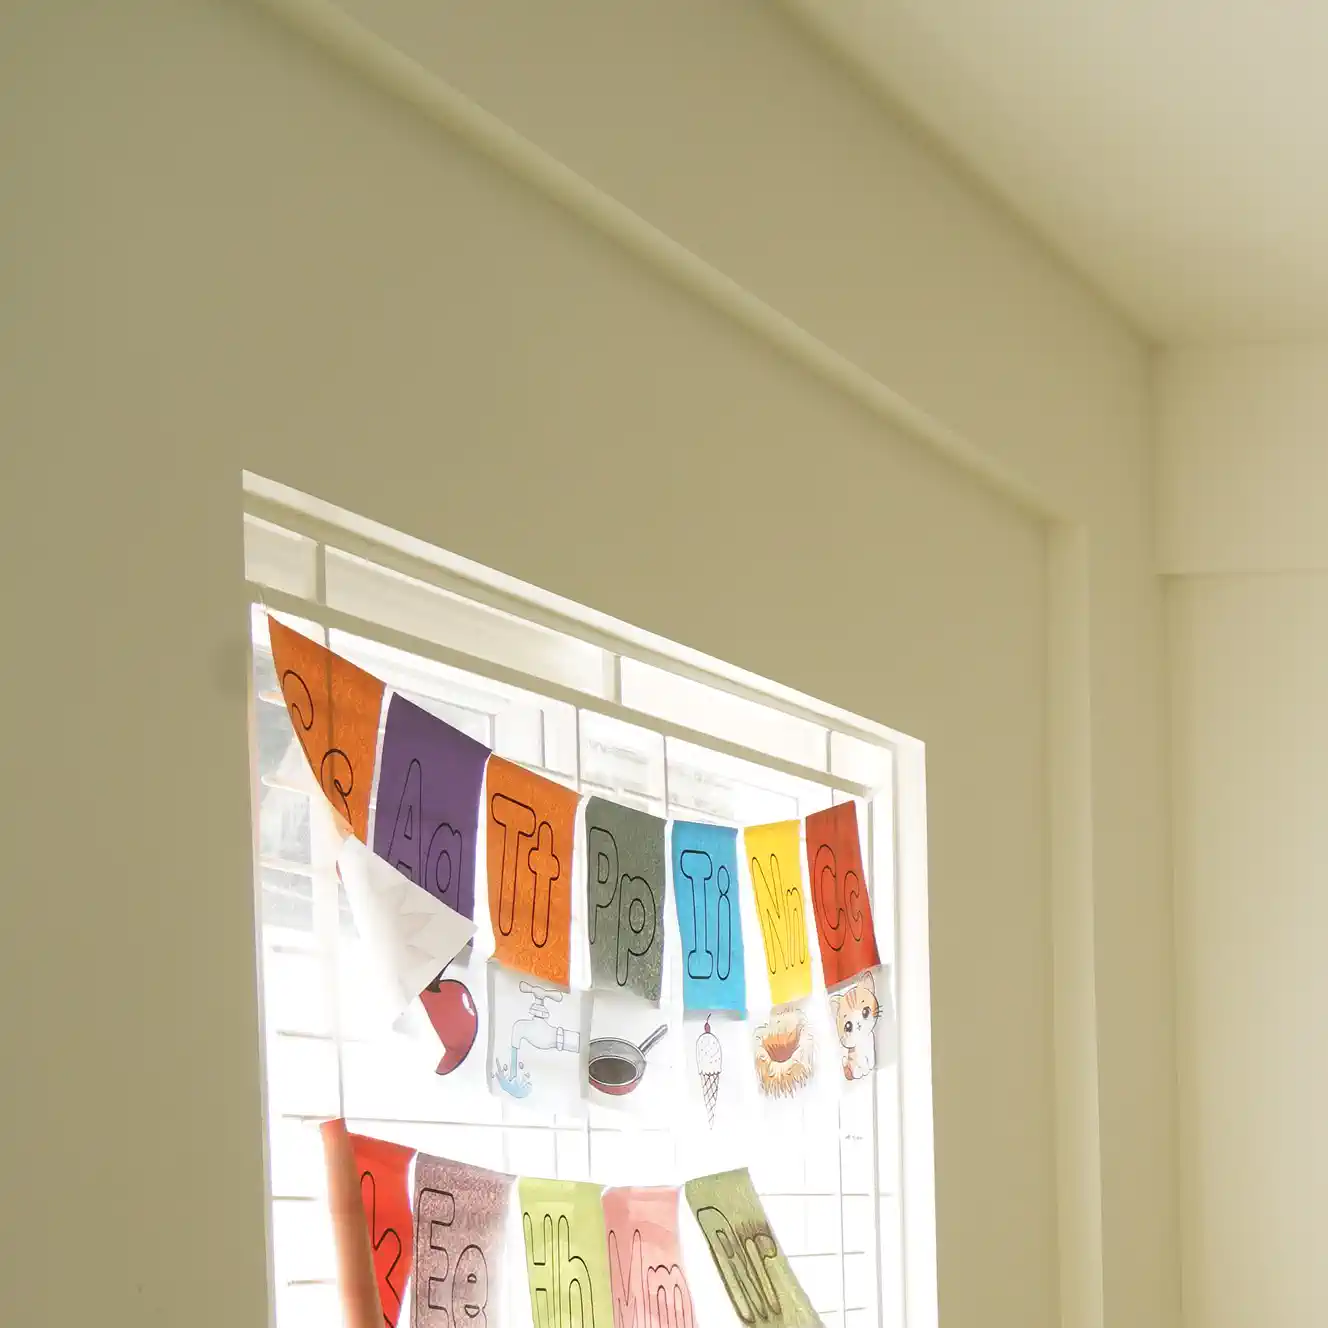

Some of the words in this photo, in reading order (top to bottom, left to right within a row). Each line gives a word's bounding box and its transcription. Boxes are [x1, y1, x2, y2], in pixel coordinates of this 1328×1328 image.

[388, 758, 463, 913] Aa
[490, 791, 561, 949] Tt
[813, 843, 865, 952] Cc
[587, 826, 657, 987] Pp
[679, 849, 733, 980] Ii
[750, 853, 806, 976] Nn
[697, 1206, 781, 1324] Rr
